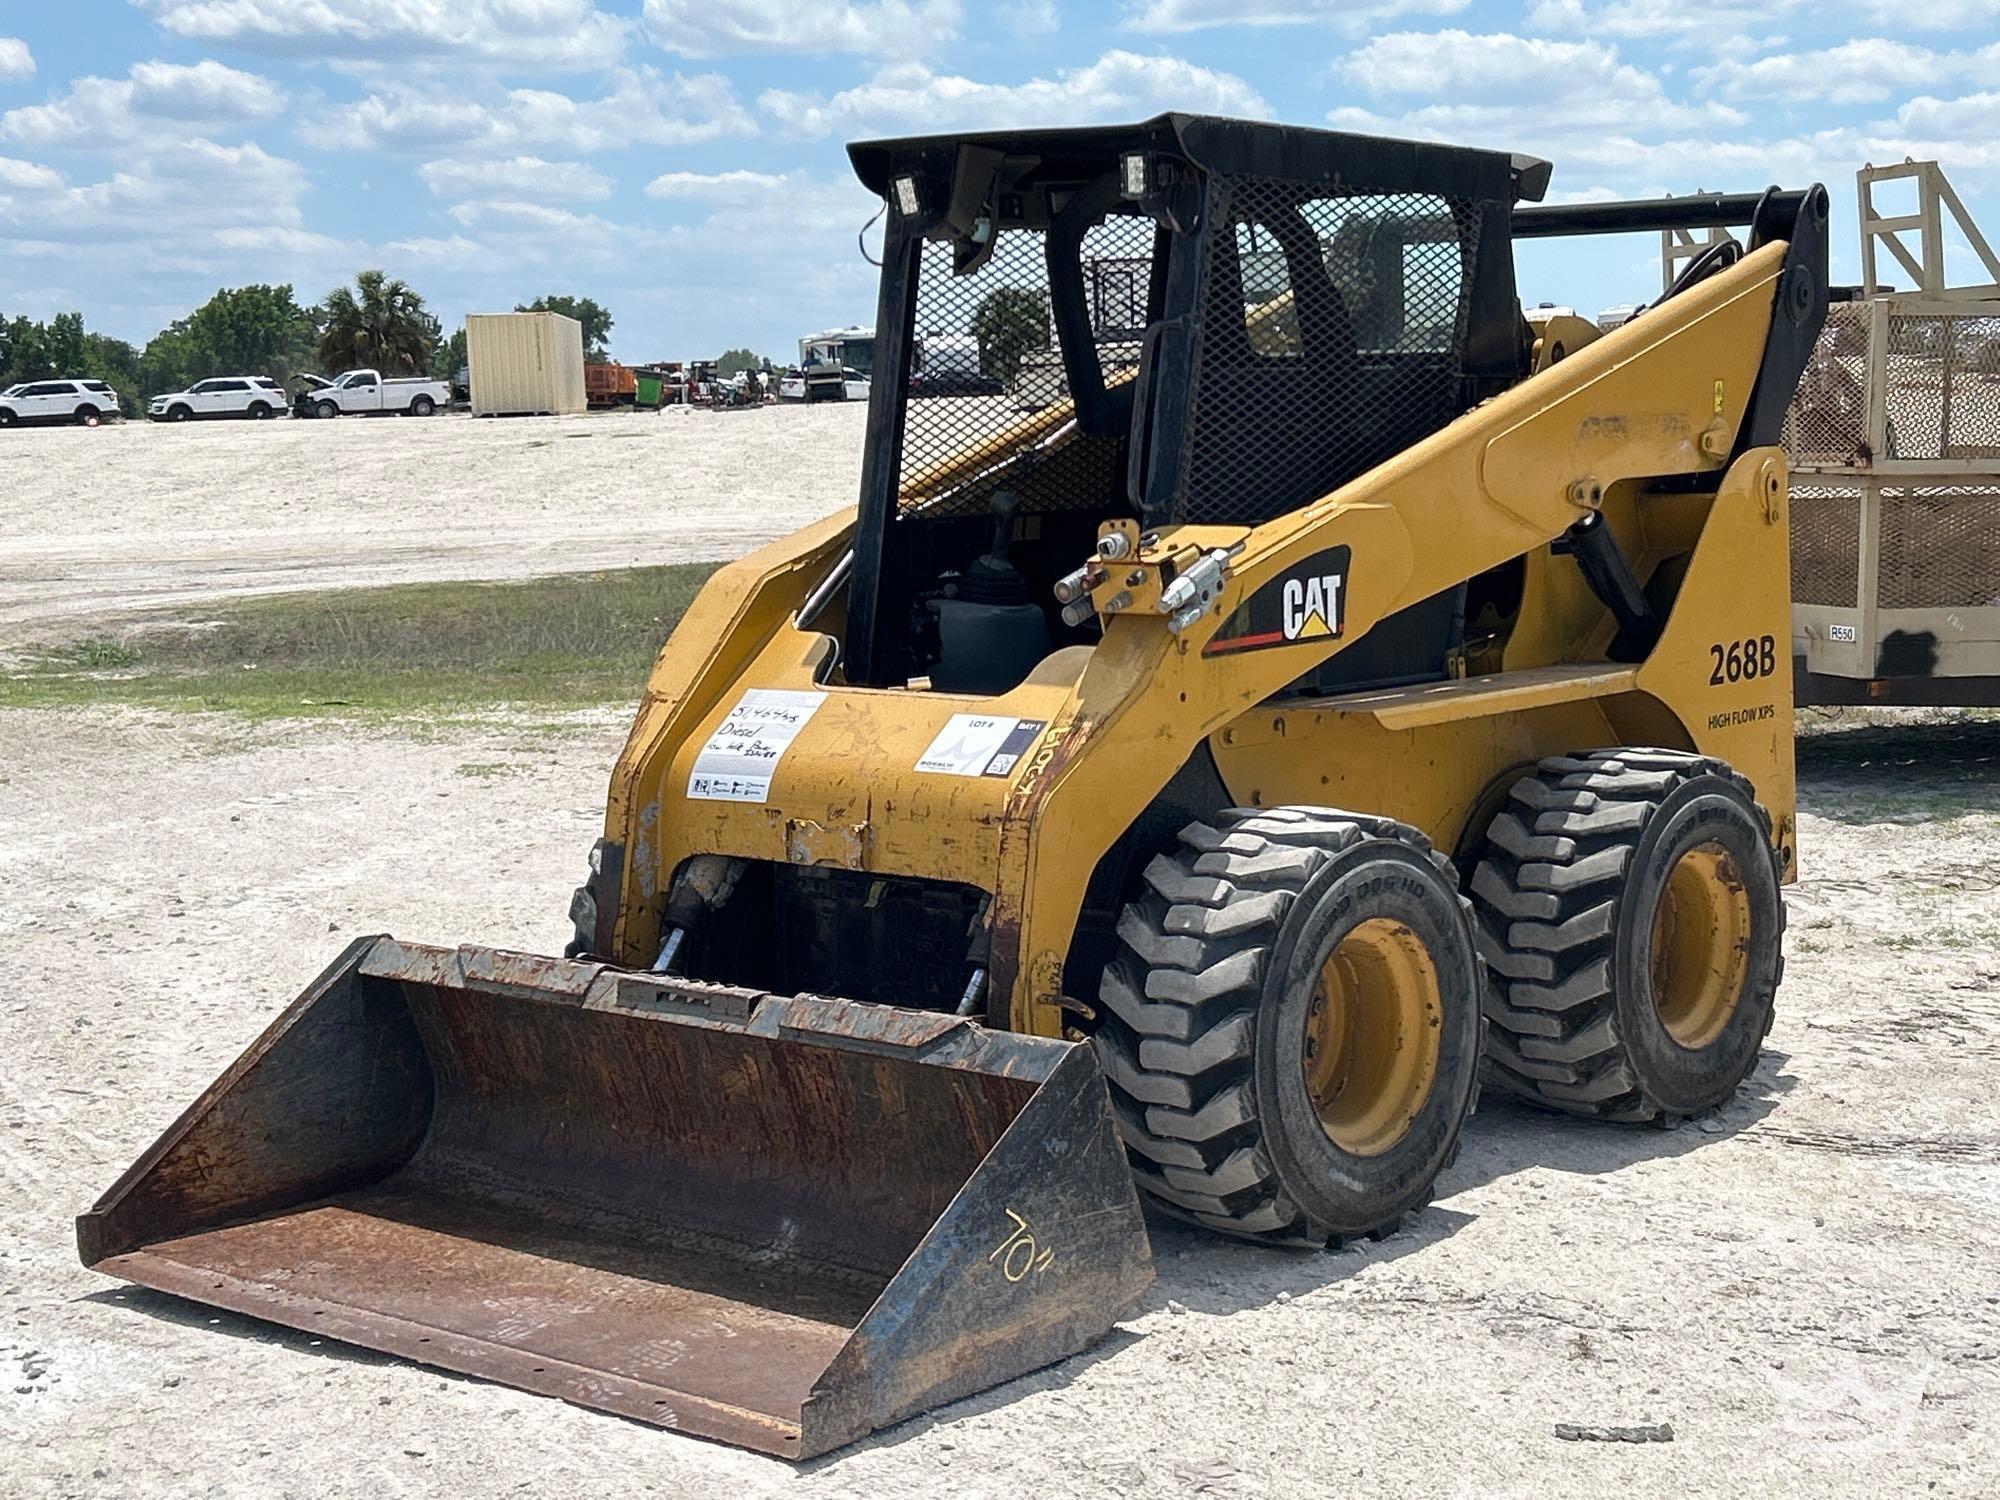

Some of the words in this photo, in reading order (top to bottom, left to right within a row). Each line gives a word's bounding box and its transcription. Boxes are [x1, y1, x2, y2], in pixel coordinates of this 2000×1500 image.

[1283, 575, 1340, 640] CAT
[1709, 634, 1775, 686] 268B
[968, 719, 985, 728] LOT
[1708, 712, 1731, 730] HIGH
[1732, 707, 1757, 726] FLOW
[1757, 704, 1775, 721] XPS
